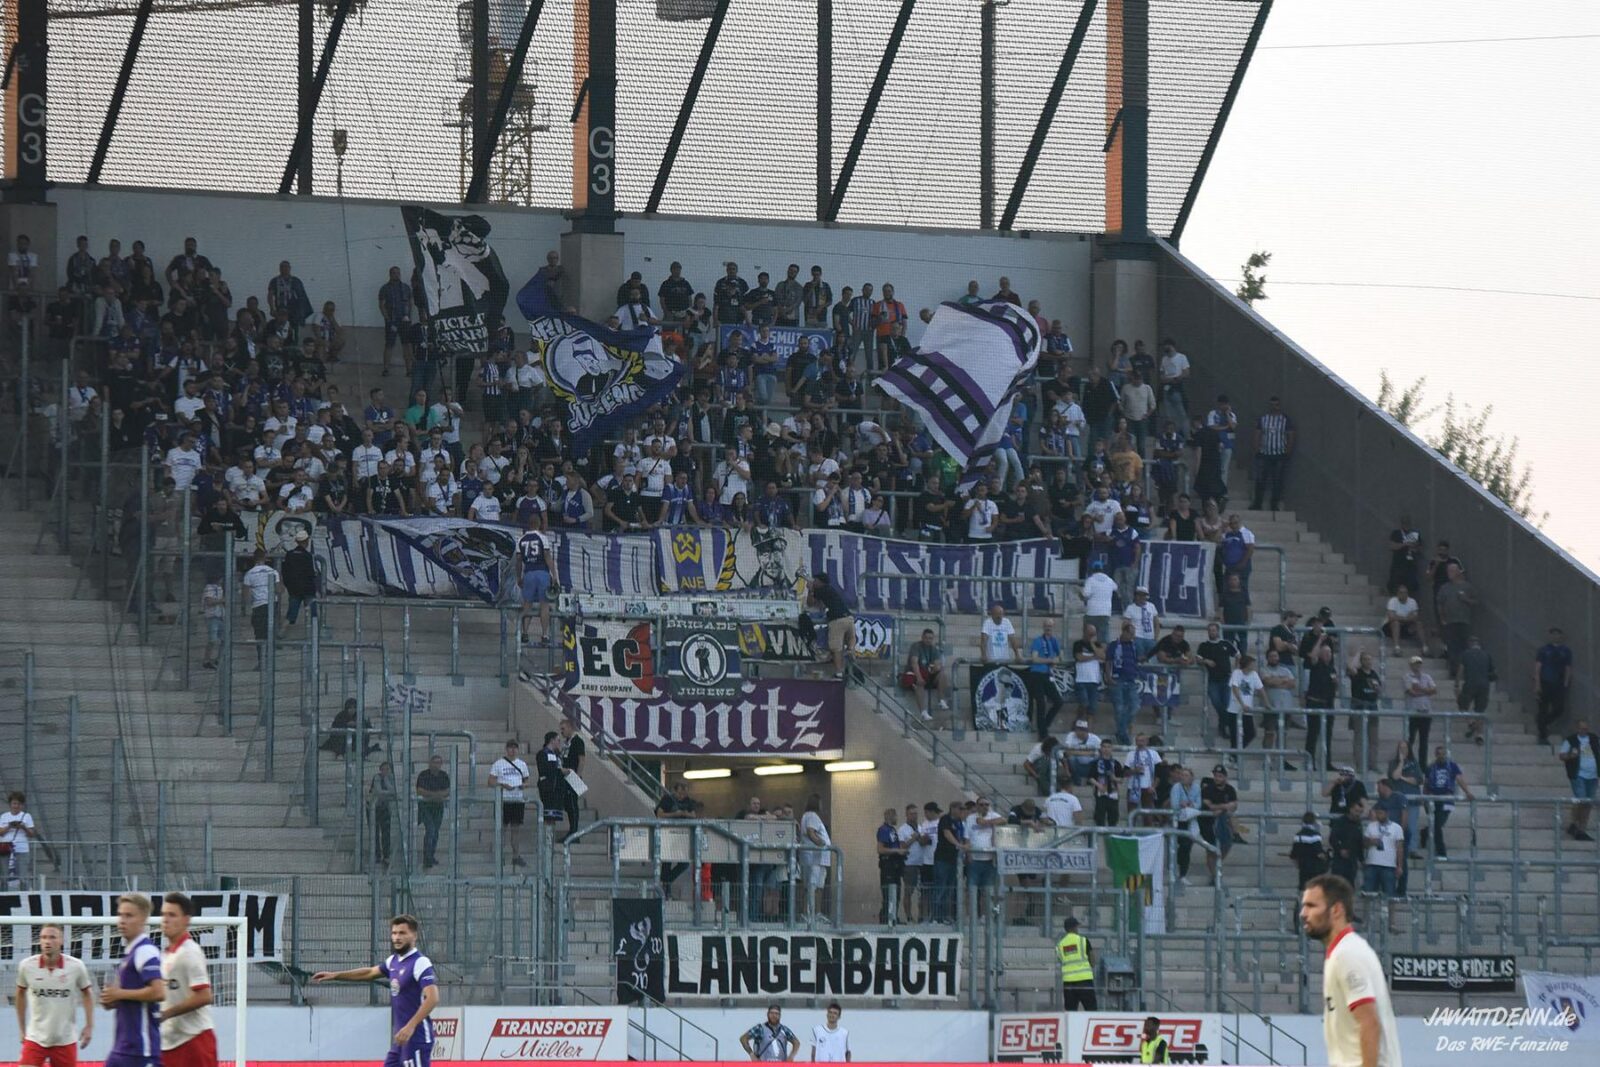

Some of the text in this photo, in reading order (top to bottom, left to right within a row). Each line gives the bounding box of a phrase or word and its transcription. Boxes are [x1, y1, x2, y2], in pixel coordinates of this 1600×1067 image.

[521, 540, 539, 557] 75
[680, 577, 704, 589] AUE
[666, 620, 738, 632] BRIGADE
[580, 637, 642, 679] EC
[600, 685, 633, 693] COMPANY
[678, 687, 735, 697] JUGEND
[667, 934, 958, 997] LANGENBACH
[1393, 958, 1514, 977] SEMPER FIDELIS
[501, 1020, 605, 1035] TRANSPORTE
[500, 1039, 583, 1059] Müller
